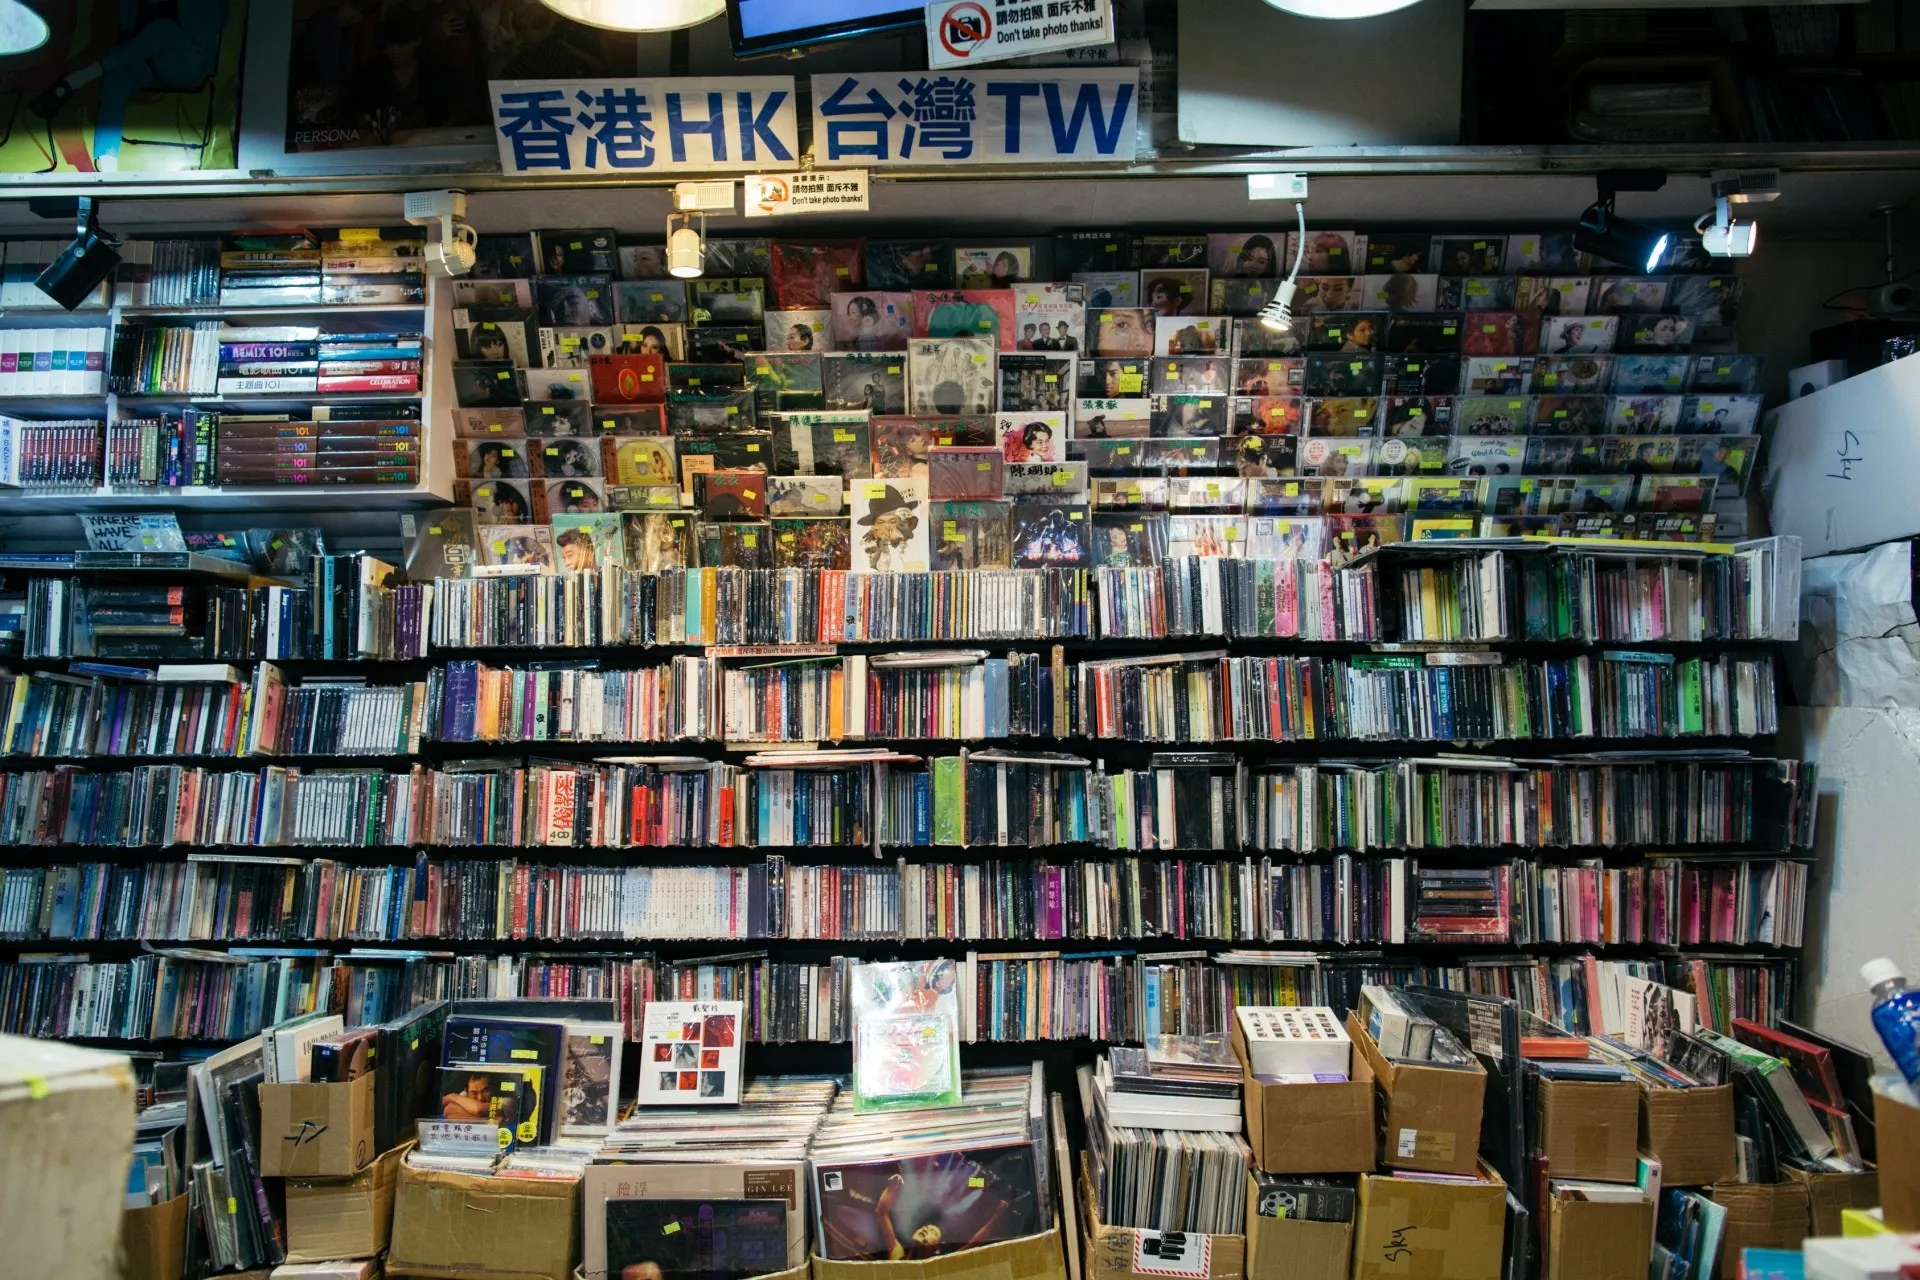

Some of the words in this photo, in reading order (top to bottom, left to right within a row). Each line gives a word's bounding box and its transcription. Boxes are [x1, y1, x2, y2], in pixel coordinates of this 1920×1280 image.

[996, 5, 1044, 26] 請勿拍照
[1048, 0, 1096, 17] 面斥不雅
[997, 28, 1020, 43] Don't
[1022, 27, 1041, 40] take
[1043, 23, 1068, 39] photo
[1070, 16, 1104, 34] thanks!
[820, 76, 975, 161] 台灣
[987, 82, 1135, 155] TW
[500, 89, 654, 171] 香港
[665, 91, 794, 162] HK
[295, 129, 360, 143] PERSONA
[792, 184, 824, 194] 請勿拍照
[826, 183, 859, 192] 面斥不雅
[792, 197, 807, 205] Don't
[808, 196, 822, 204] take
[822, 195, 840, 205] photo
[840, 195, 863, 203] thanks!
[232, 347, 266, 358] REMIX
[268, 346, 288, 357] 101
[295, 427, 309, 436] 101
[395, 426, 409, 435] 101
[294, 443, 308, 452] 101
[395, 442, 409, 451] 101
[293, 458, 307, 468] 101
[394, 457, 407, 466] 101
[293, 474, 307, 483] 101
[394, 473, 407, 481] 101
[88, 515, 141, 526] WHERE
[93, 527, 131, 537] HAVE
[98, 540, 124, 550] ALL
[281, 593, 290, 606] Jay
[763, 646, 780, 654] Don't
[1439, 684, 1448, 713] BEYOND
[747, 1184, 767, 1193] GIN
[772, 1184, 793, 1193] LEE
[1384, 1225, 1418, 1262] Sky
